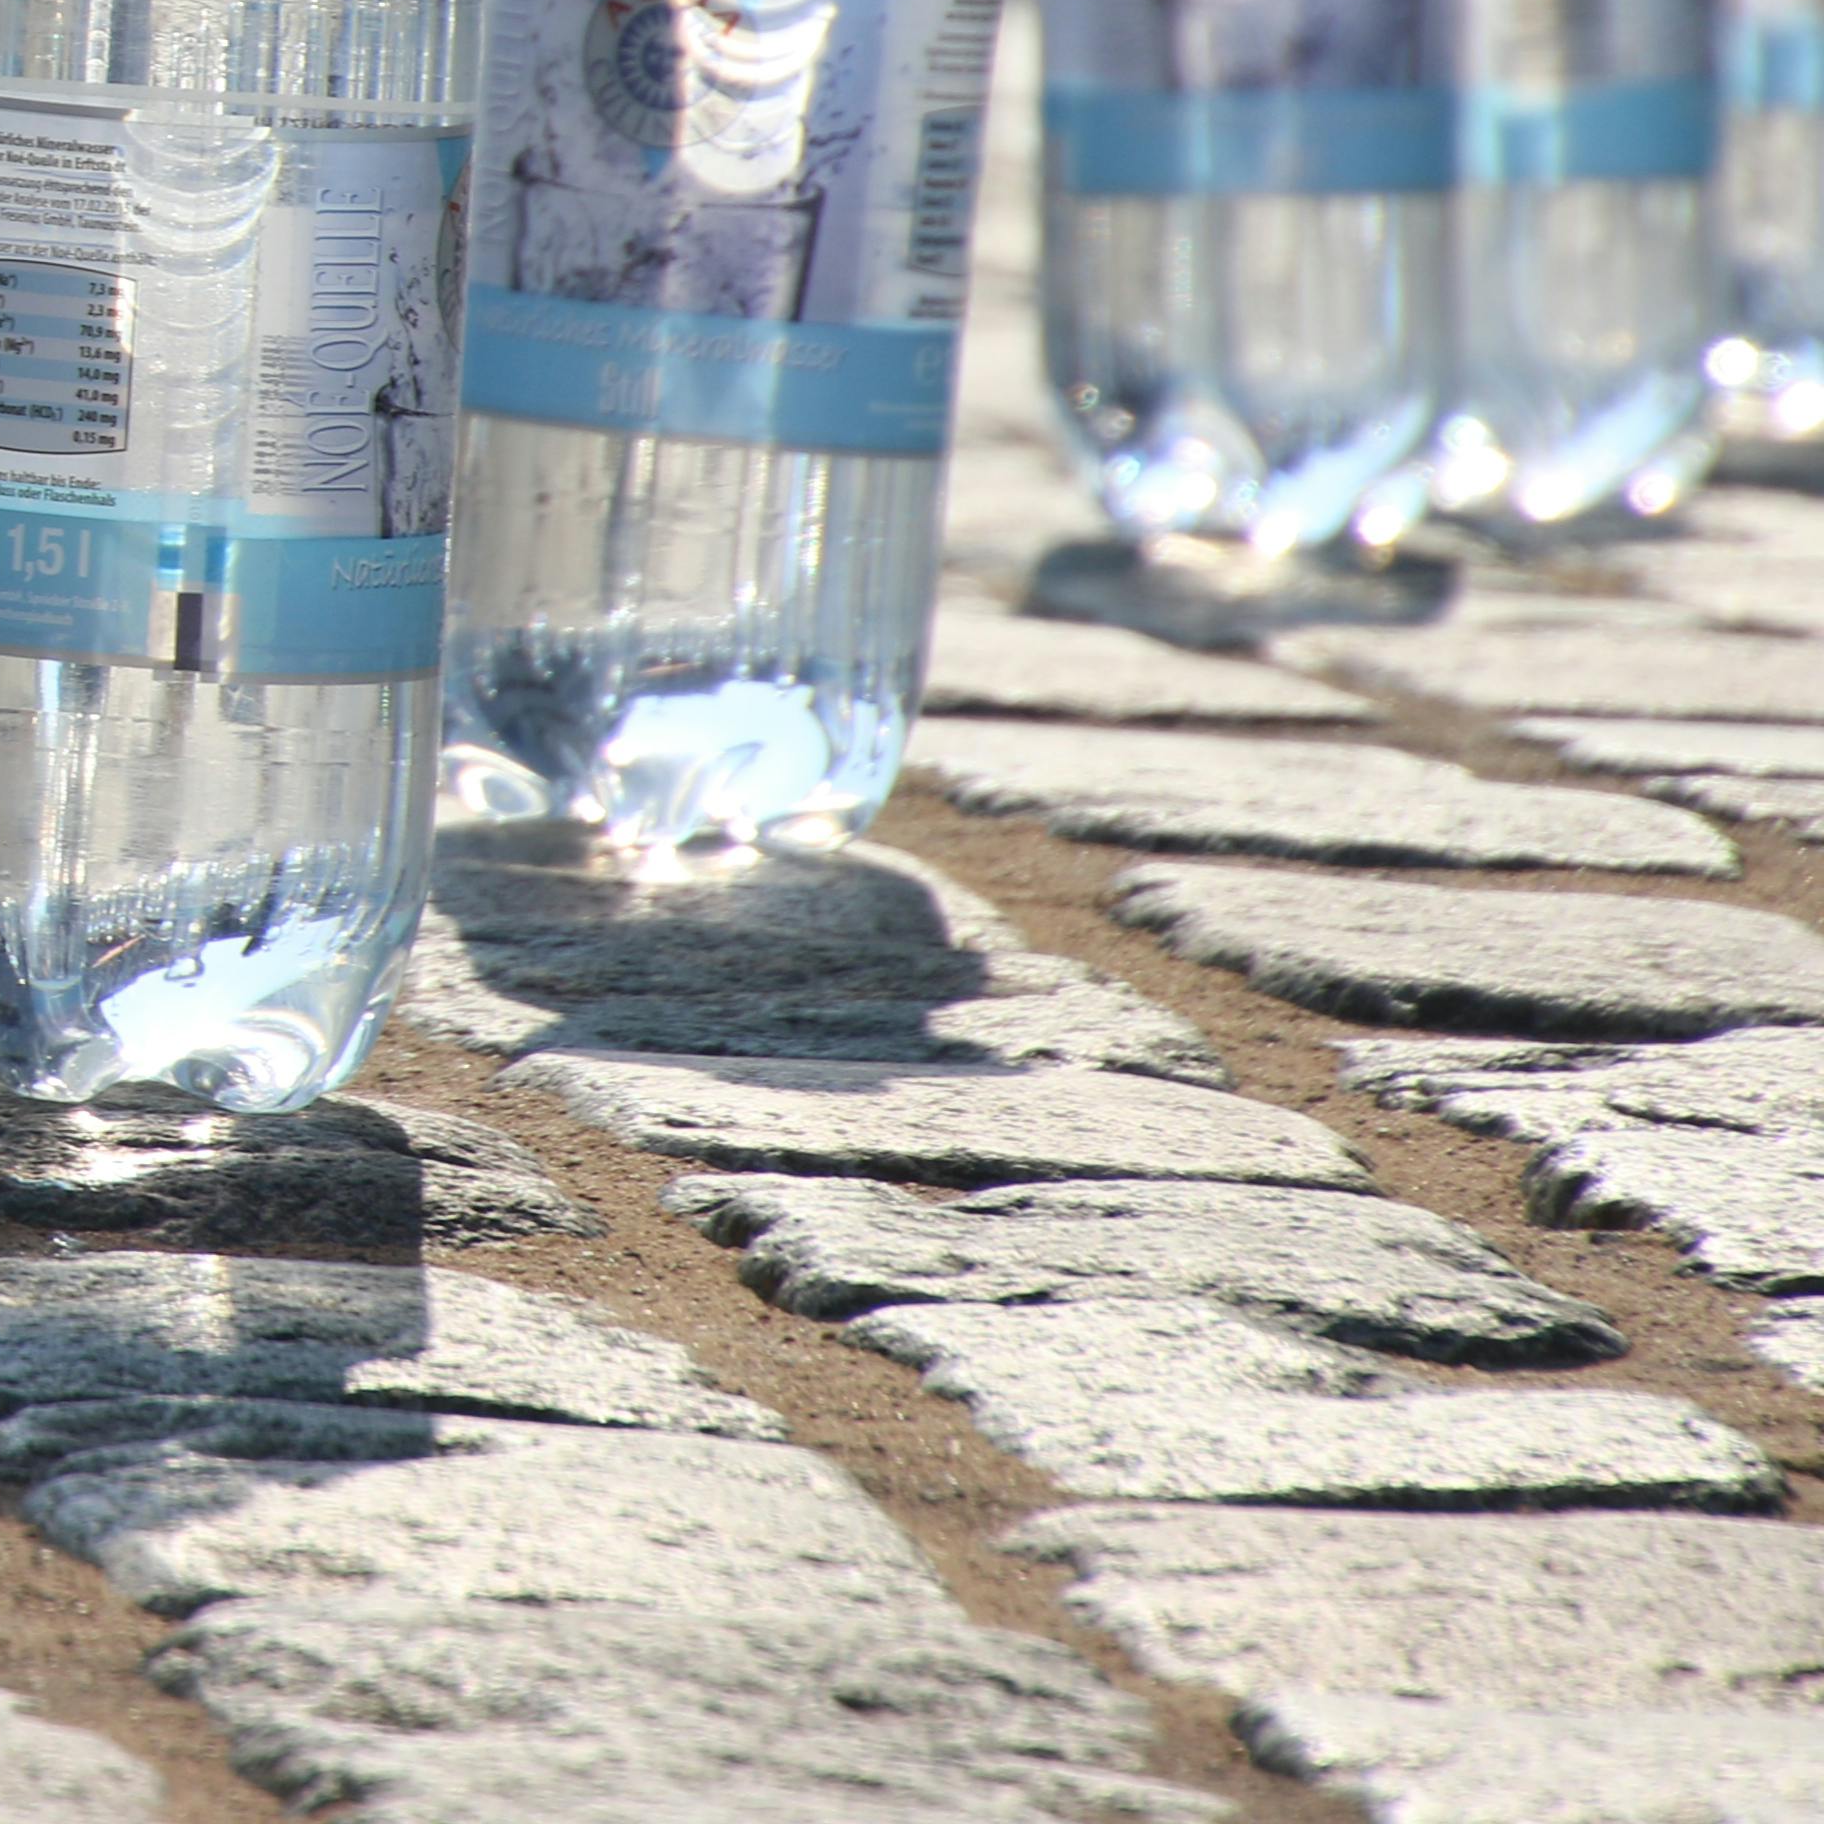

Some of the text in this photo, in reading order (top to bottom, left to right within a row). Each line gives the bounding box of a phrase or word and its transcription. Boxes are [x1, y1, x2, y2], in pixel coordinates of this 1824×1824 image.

[103, 350, 122, 364] mg
[102, 371, 120, 385] mg
[100, 393, 119, 406] mg
[77, 409, 98, 422] 240
[99, 414, 118, 428] mg
[97, 434, 117, 448] mg
[10, 469, 49, 486] haltbar
[50, 473, 67, 488] bis
[17, 486, 43, 500] oder
[44, 488, 116, 507] Flaschenhals
[6, 523, 66, 582] 1,5
